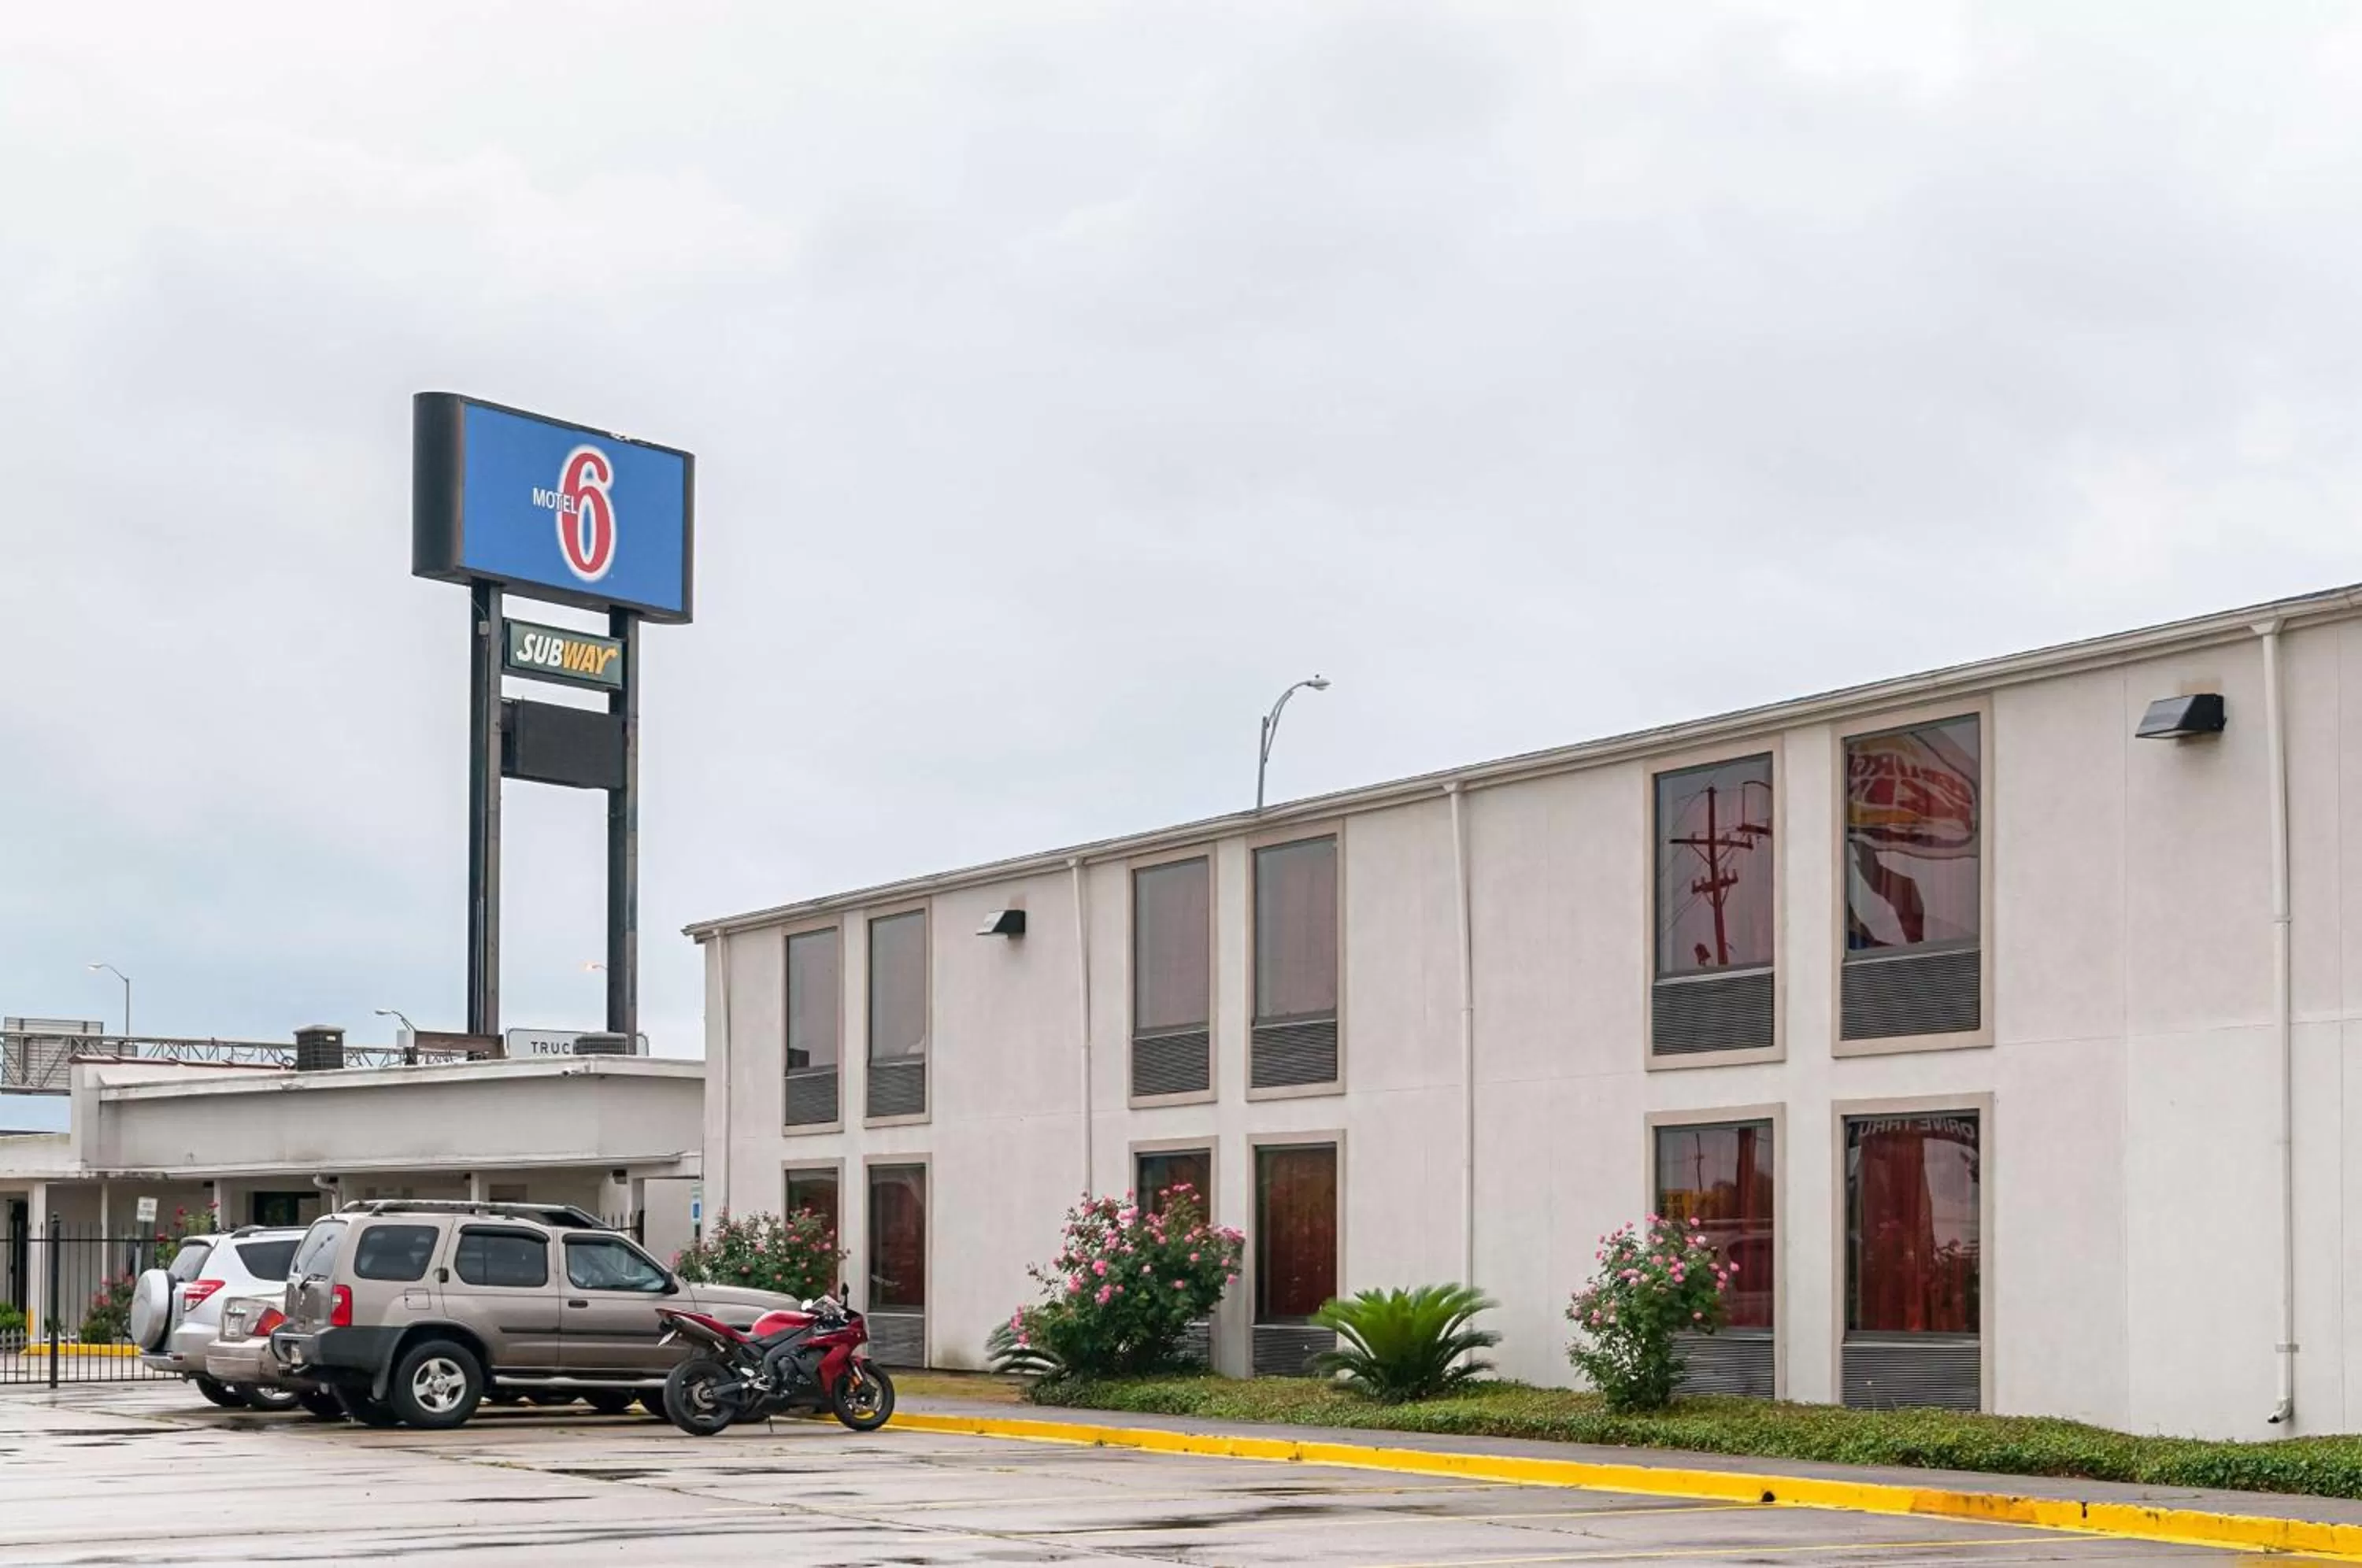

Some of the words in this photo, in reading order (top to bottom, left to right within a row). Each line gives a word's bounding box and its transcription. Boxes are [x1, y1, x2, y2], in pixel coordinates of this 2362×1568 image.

[532, 487, 578, 515] MOTEL
[556, 444, 616, 582] 6
[516, 633, 619, 675] SUBWAY
[530, 1041, 571, 1055] TRUC
